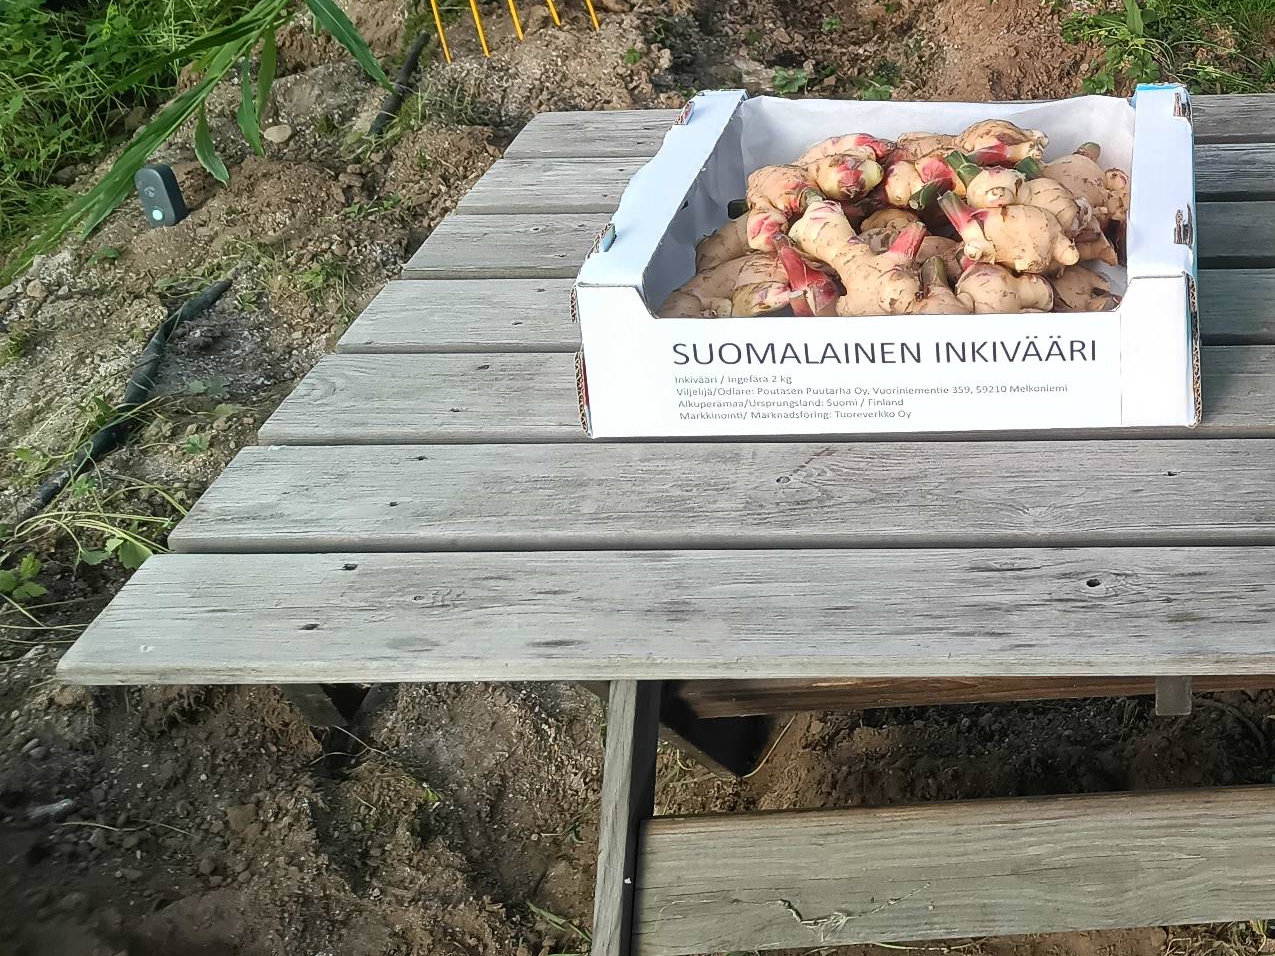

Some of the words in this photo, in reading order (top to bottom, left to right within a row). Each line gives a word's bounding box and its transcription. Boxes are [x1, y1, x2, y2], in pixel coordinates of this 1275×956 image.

[672, 342, 922, 364] SUOMALAINEN
[935, 333, 1097, 362] INKIVÄÄRI
[771, 375, 778, 383] 2
[780, 374, 792, 385] kg
[806, 387, 851, 396] Puutarha
[976, 385, 1007, 394] 59210
[826, 398, 858, 407] Suomi
[868, 398, 904, 407] Finland
[897, 410, 912, 419] Oy
